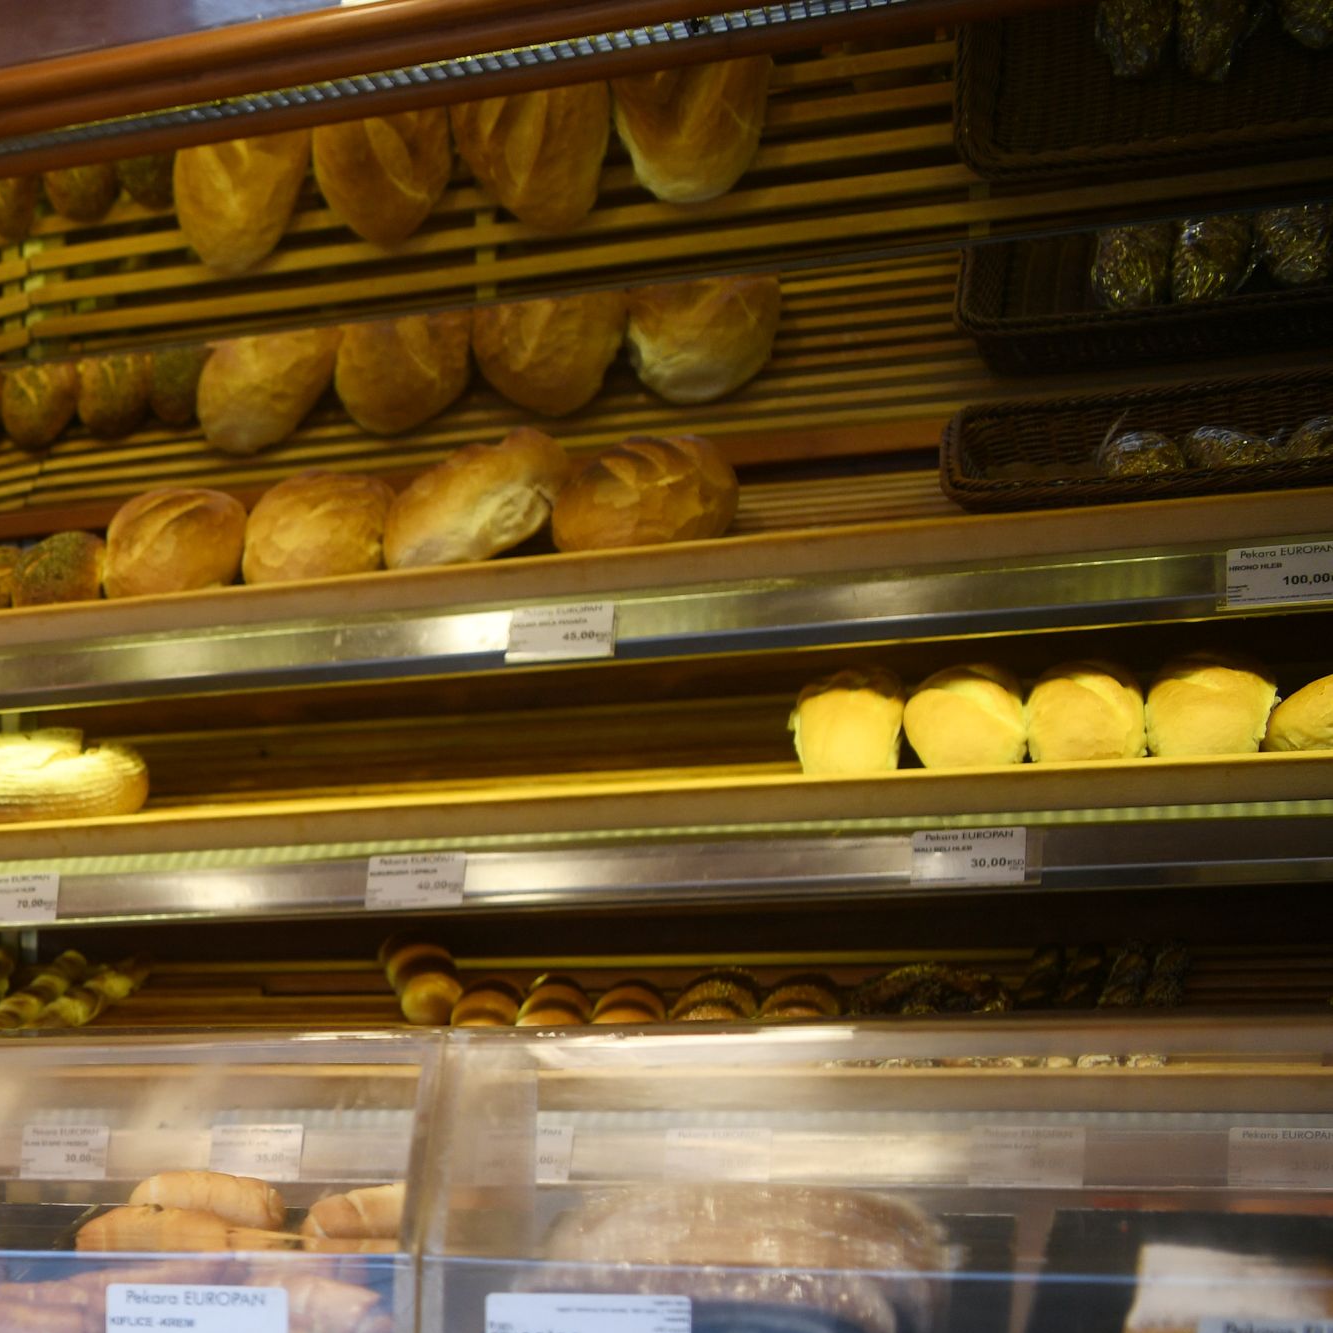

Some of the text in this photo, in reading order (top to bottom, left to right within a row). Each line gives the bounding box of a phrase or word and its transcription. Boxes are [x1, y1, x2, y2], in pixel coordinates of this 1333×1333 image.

[1241, 550, 1276, 558] Pekara
[963, 831, 1013, 839] EUROPAN
[126, 1290, 266, 1306] Pekara EUROPAN
